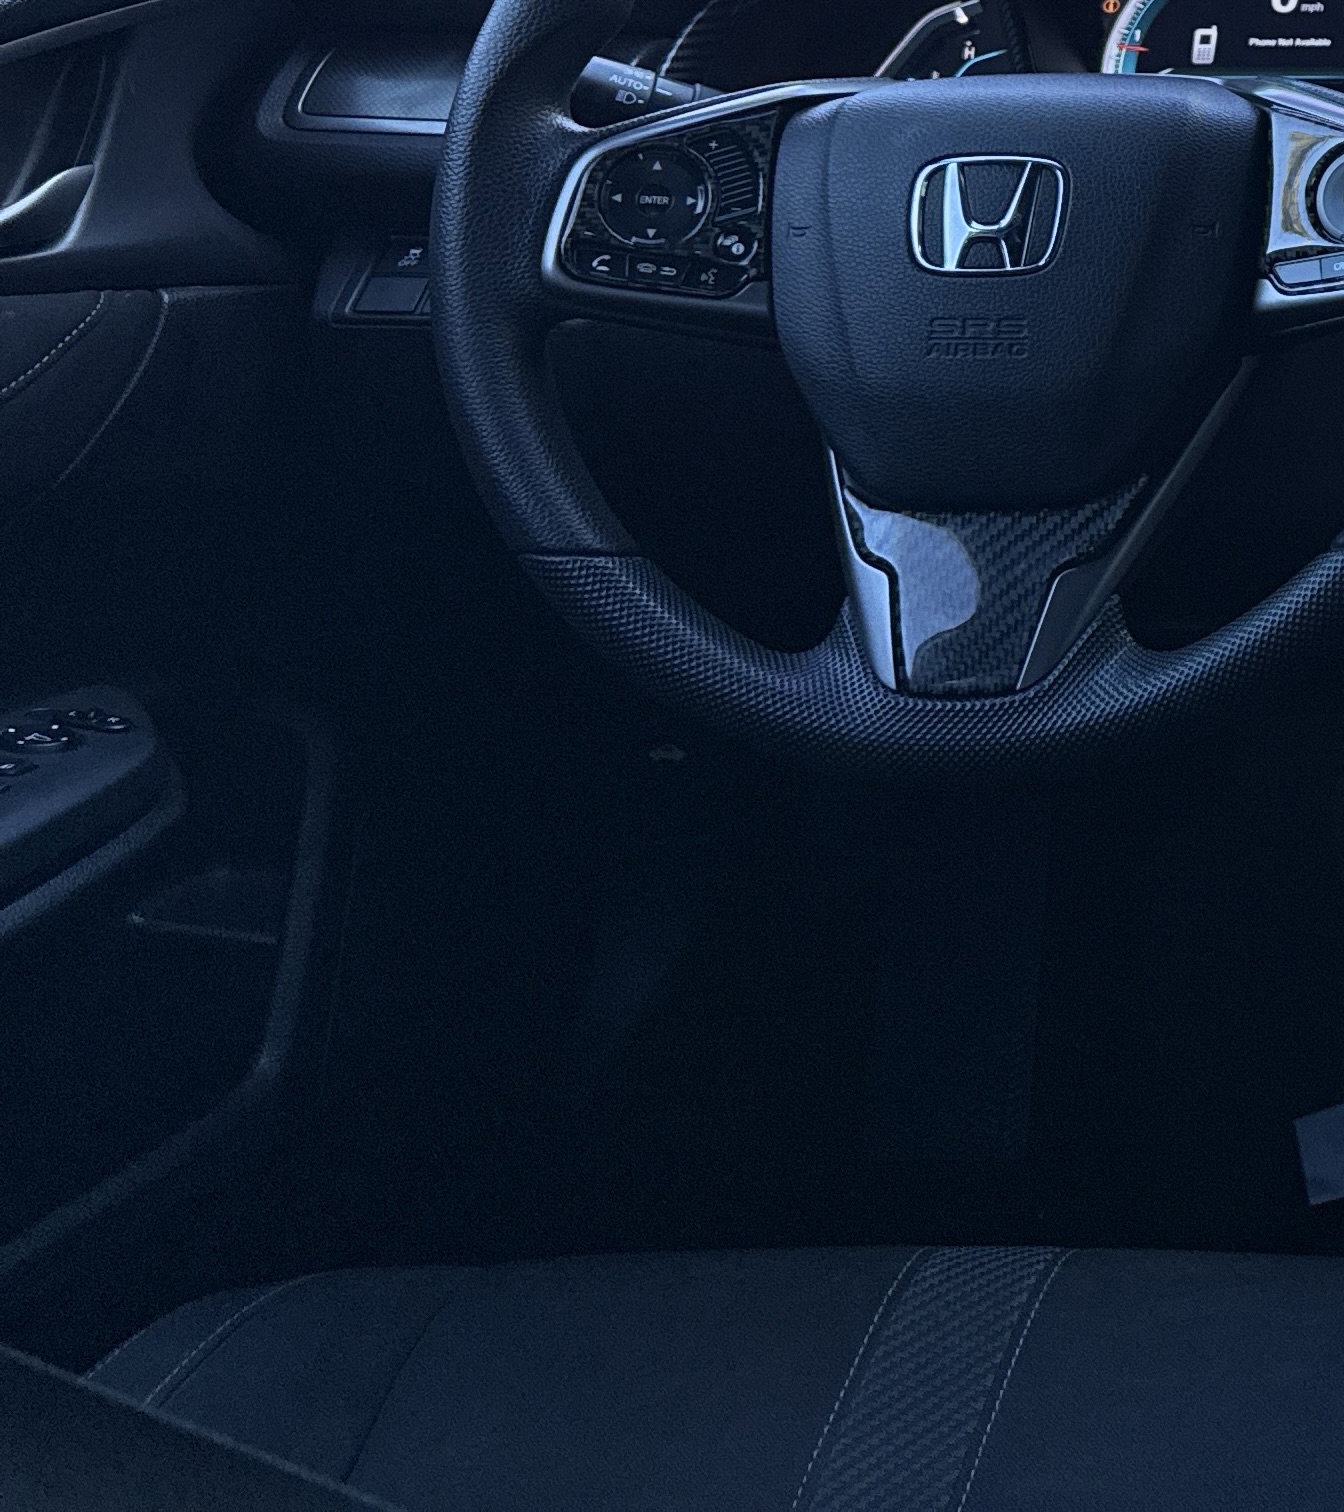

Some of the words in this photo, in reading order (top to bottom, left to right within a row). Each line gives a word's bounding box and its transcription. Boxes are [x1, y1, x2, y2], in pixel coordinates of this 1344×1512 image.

[1301, 1, 1325, 14] mph
[639, 194, 670, 207] ENTER
[928, 316, 1030, 338] SRS
[926, 340, 1030, 361] AIRBAG
